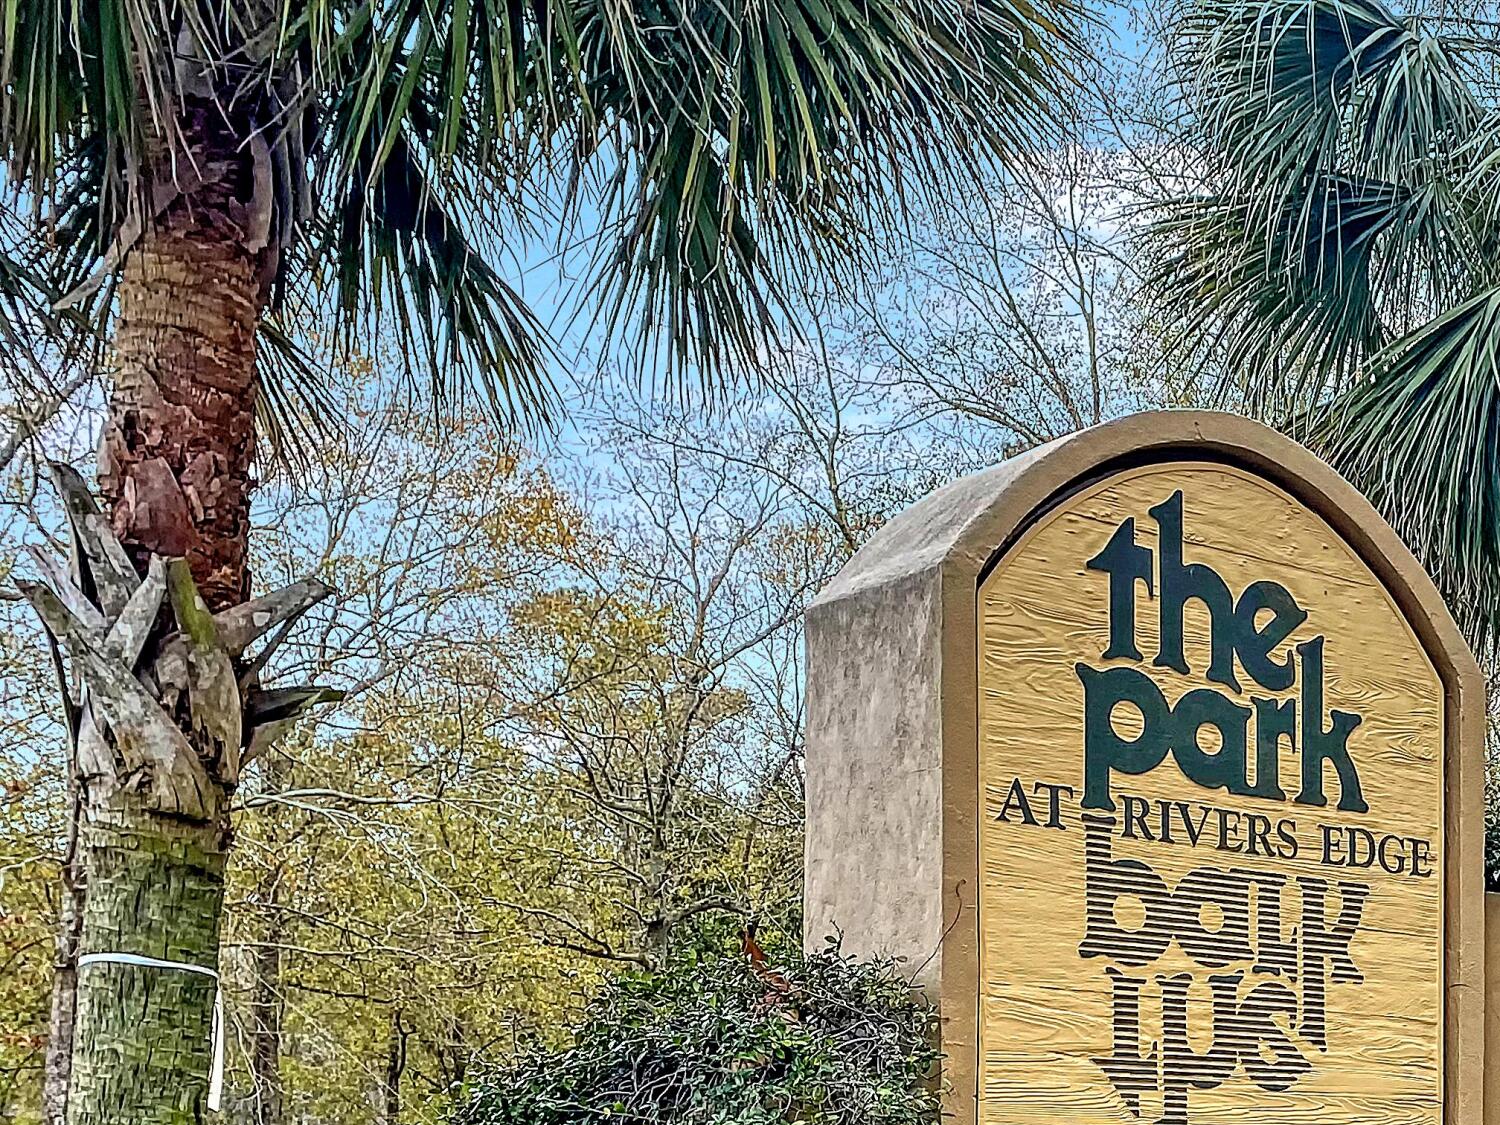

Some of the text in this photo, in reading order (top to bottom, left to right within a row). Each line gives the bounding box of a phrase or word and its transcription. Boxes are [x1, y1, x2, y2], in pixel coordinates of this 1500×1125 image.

[1086, 489, 1308, 694] the
[1075, 635, 1369, 813] park
[995, 777, 1432, 878] AT RIVERS EDGE
